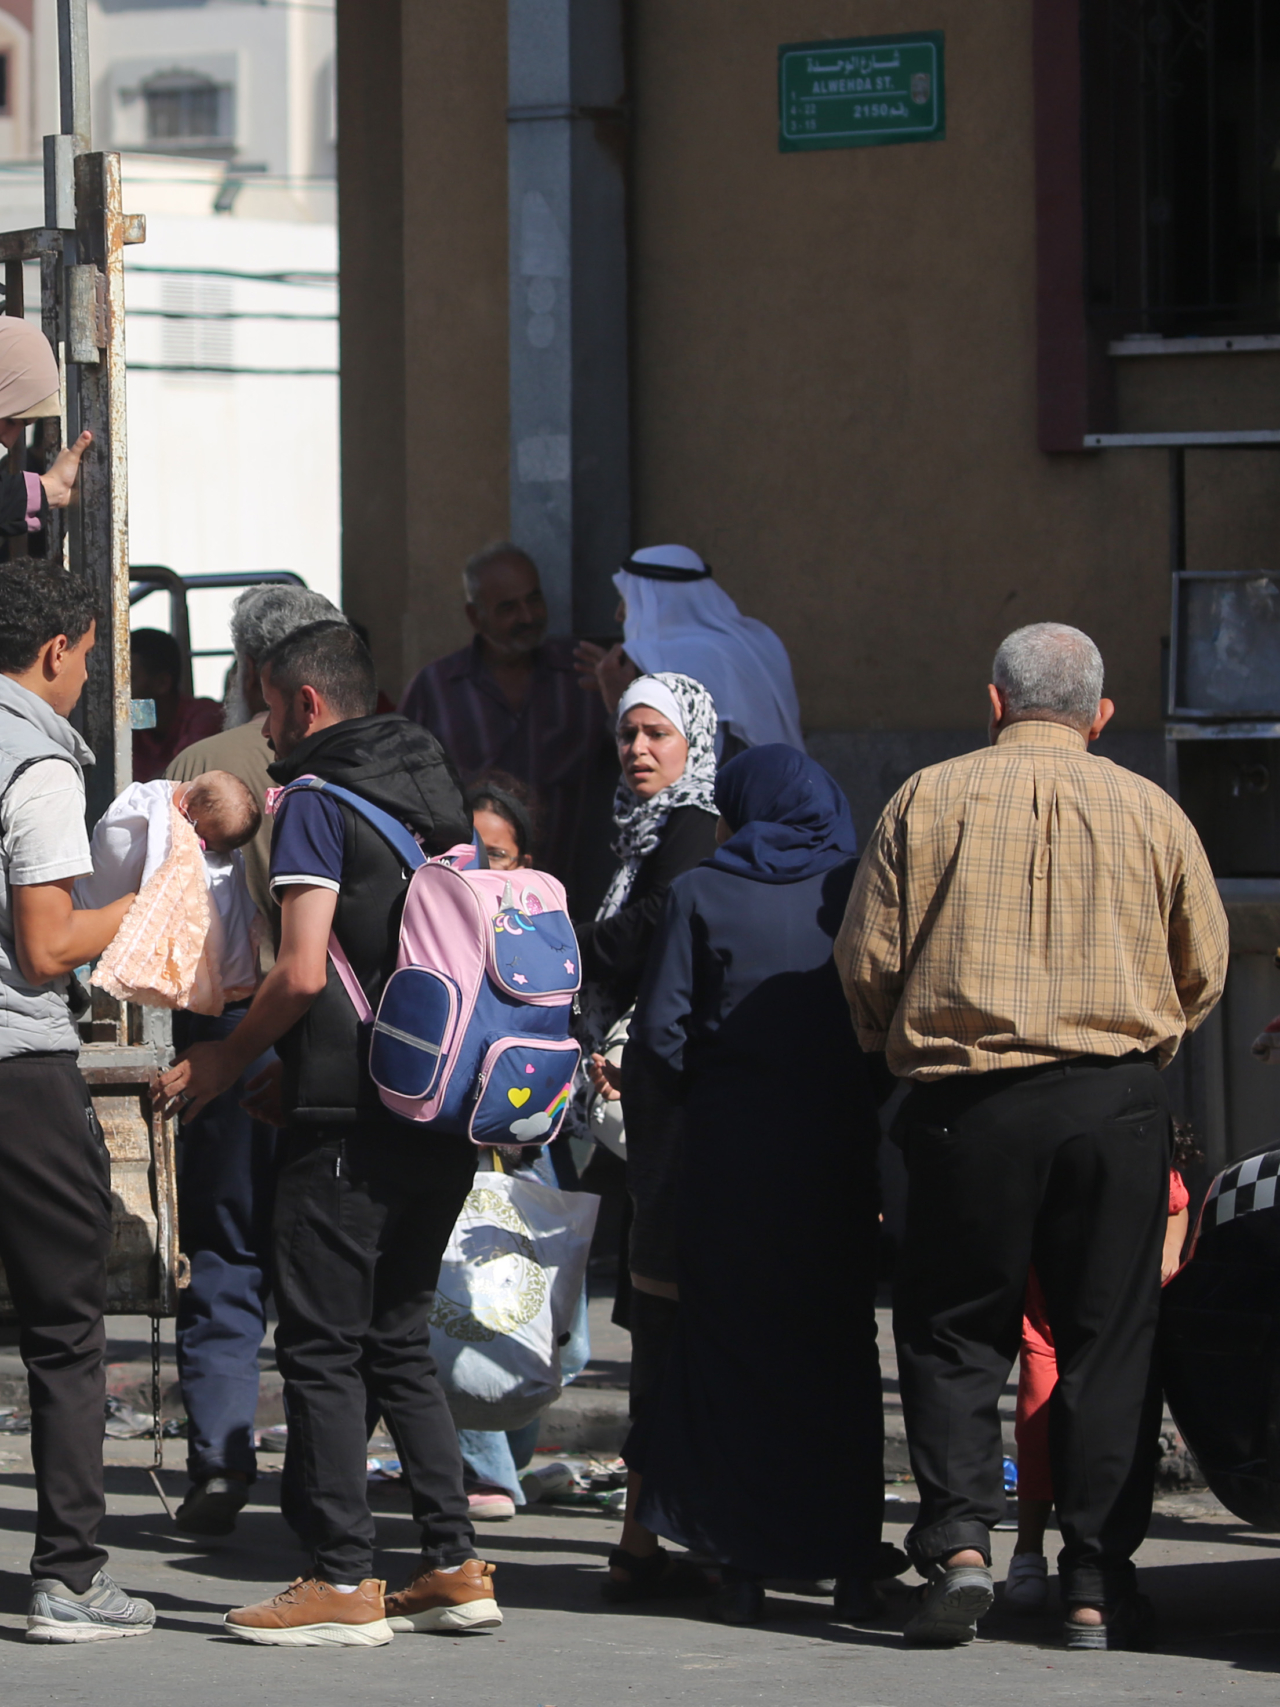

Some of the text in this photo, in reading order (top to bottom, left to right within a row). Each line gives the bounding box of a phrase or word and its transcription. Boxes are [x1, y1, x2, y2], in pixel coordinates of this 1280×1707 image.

[806, 49, 900, 75] شارع الوحدة
[812, 75, 895, 94] ALWEHDA ST.
[853, 101, 910, 118] رقم 2150
